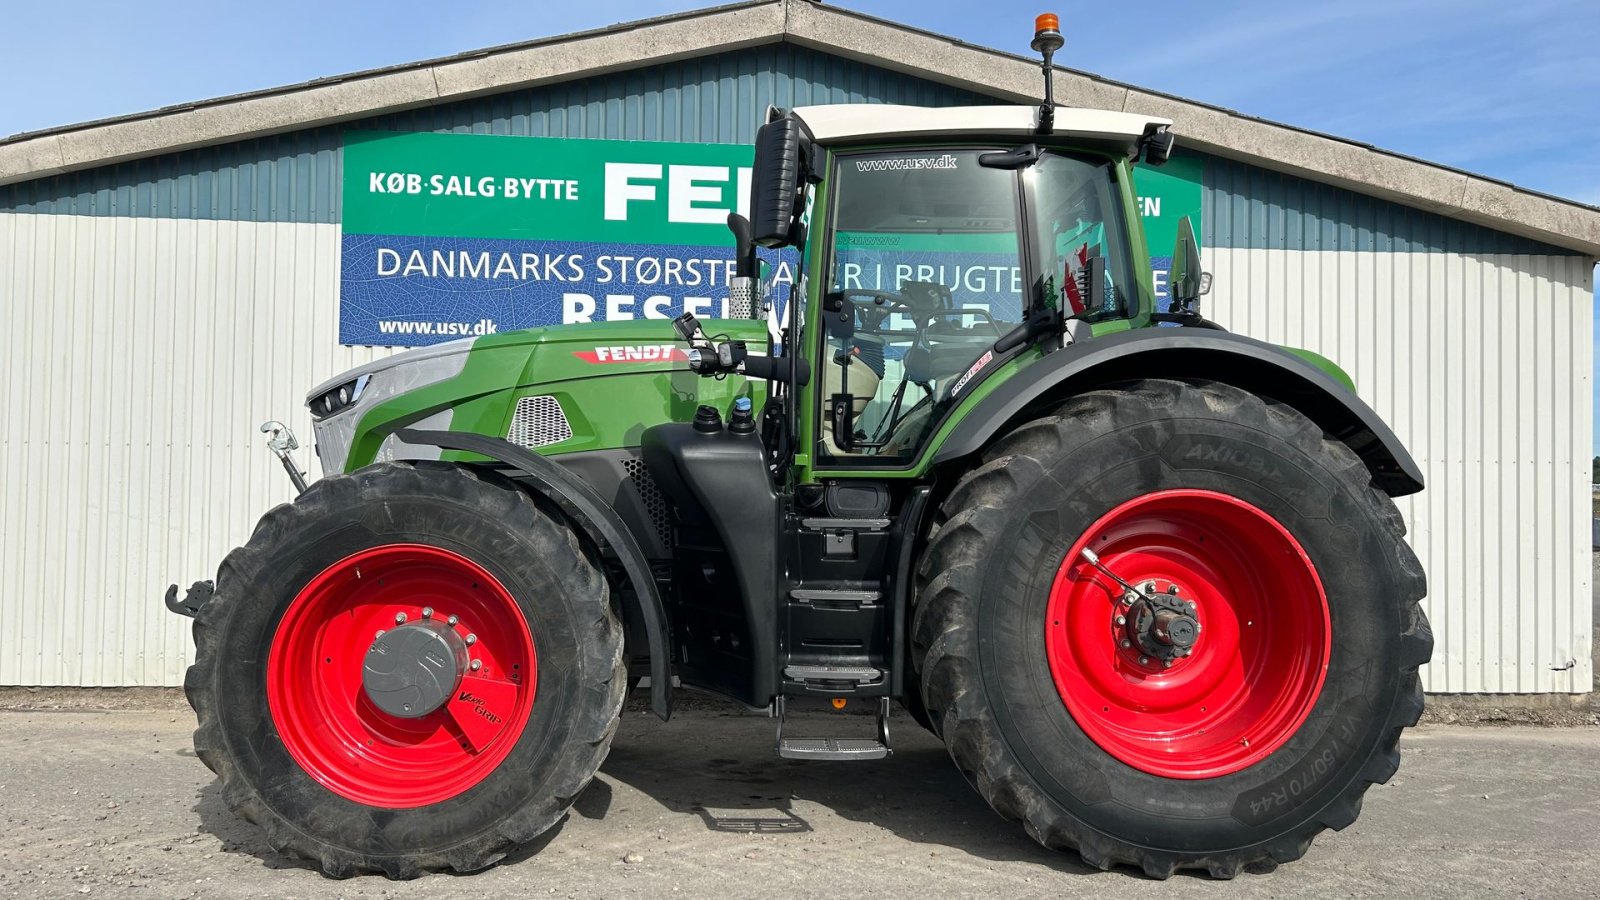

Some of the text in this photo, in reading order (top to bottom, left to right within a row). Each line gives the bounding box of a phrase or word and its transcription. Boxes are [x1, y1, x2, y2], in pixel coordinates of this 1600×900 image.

[856, 154, 957, 171] www.usv.dk
[377, 247, 584, 282] DANMARKS
[378, 318, 497, 336] www.usv.dk
[594, 344, 676, 361] FENDT
[474, 706, 502, 723] GRIP
